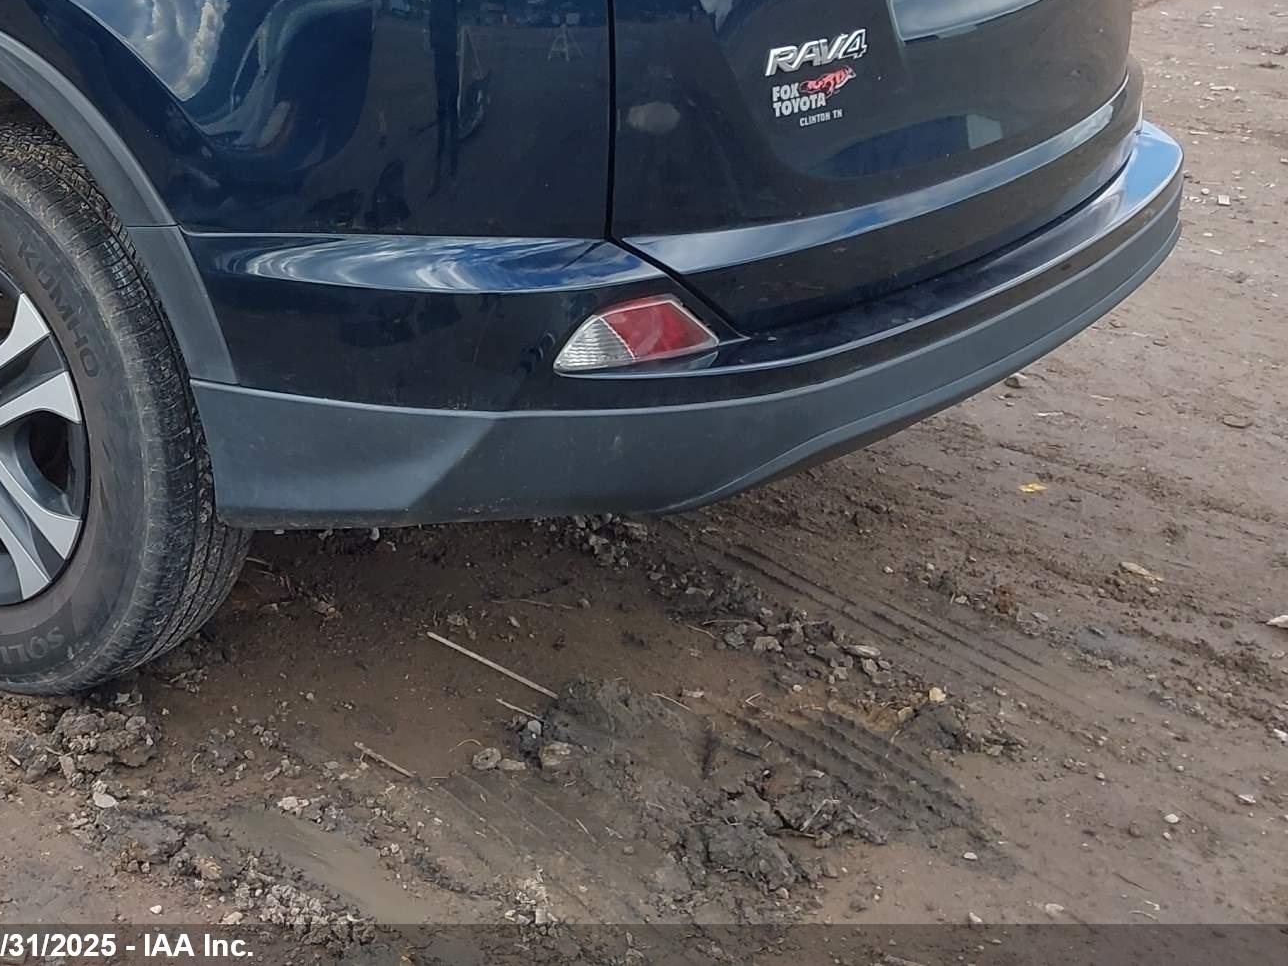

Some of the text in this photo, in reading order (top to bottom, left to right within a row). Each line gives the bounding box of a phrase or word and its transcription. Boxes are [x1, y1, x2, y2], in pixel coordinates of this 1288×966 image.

[765, 29, 868, 76] RAV4
[772, 83, 799, 102] FOX
[773, 92, 827, 117] TOYOTA
[799, 112, 831, 127] CLINTON
